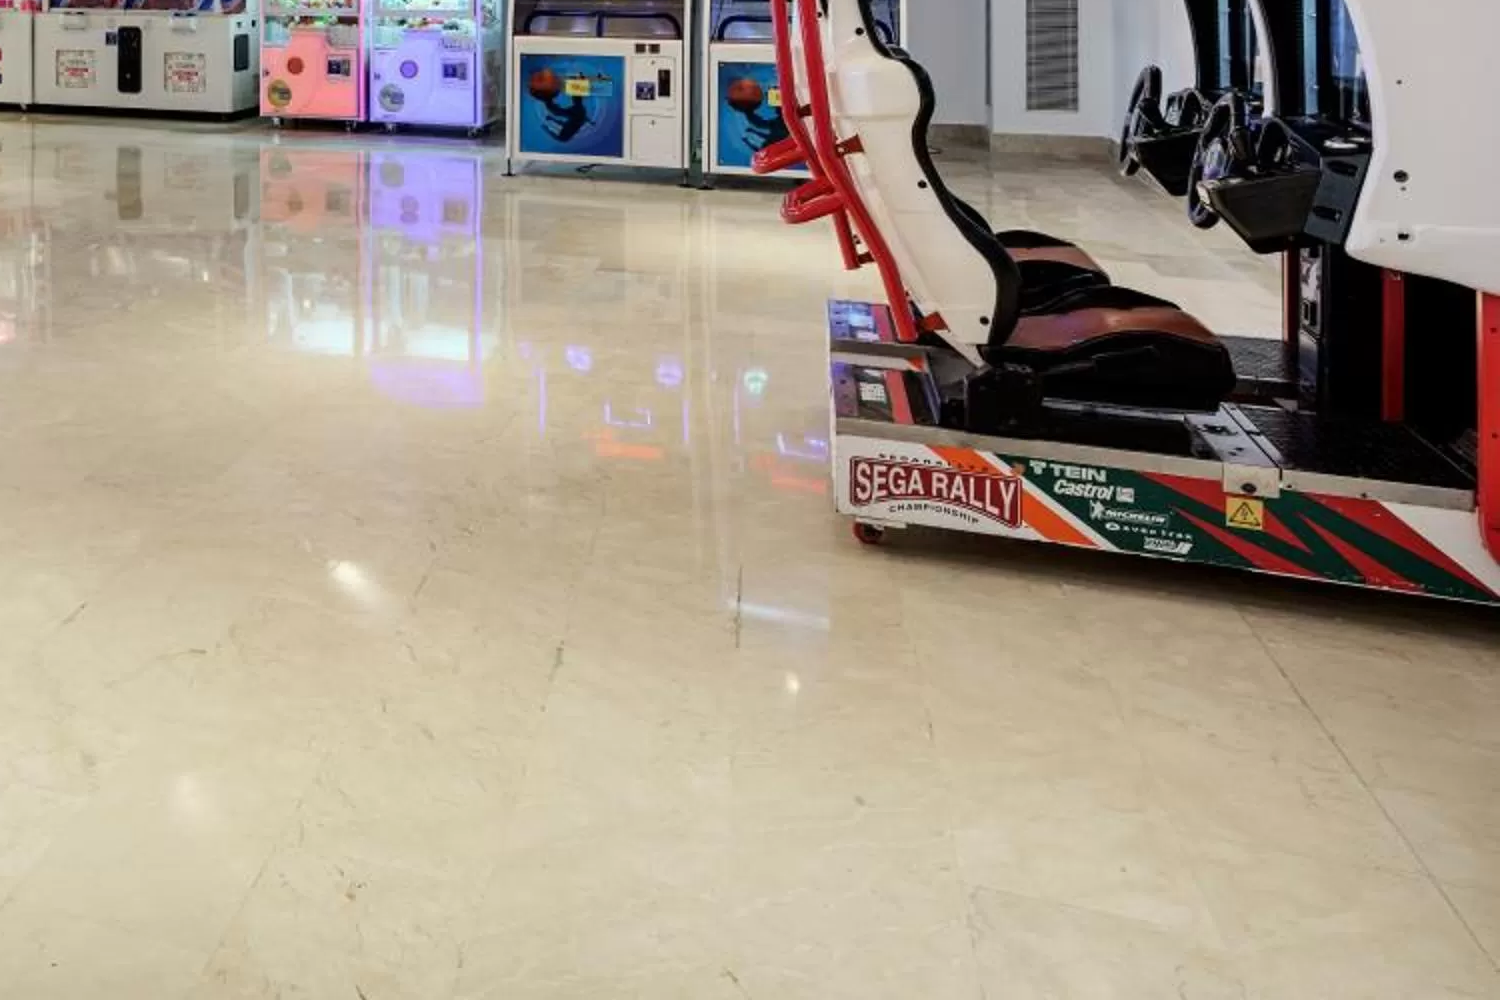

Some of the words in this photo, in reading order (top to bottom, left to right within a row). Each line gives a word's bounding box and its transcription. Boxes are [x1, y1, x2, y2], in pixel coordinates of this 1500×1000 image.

[1050, 464, 1106, 482] TEIN
[855, 461, 925, 502] SEGA
[931, 471, 1016, 520] RALLY
[1054, 479, 1114, 501] Castrol
[888, 502, 979, 524] CHAMPIONSHIP
